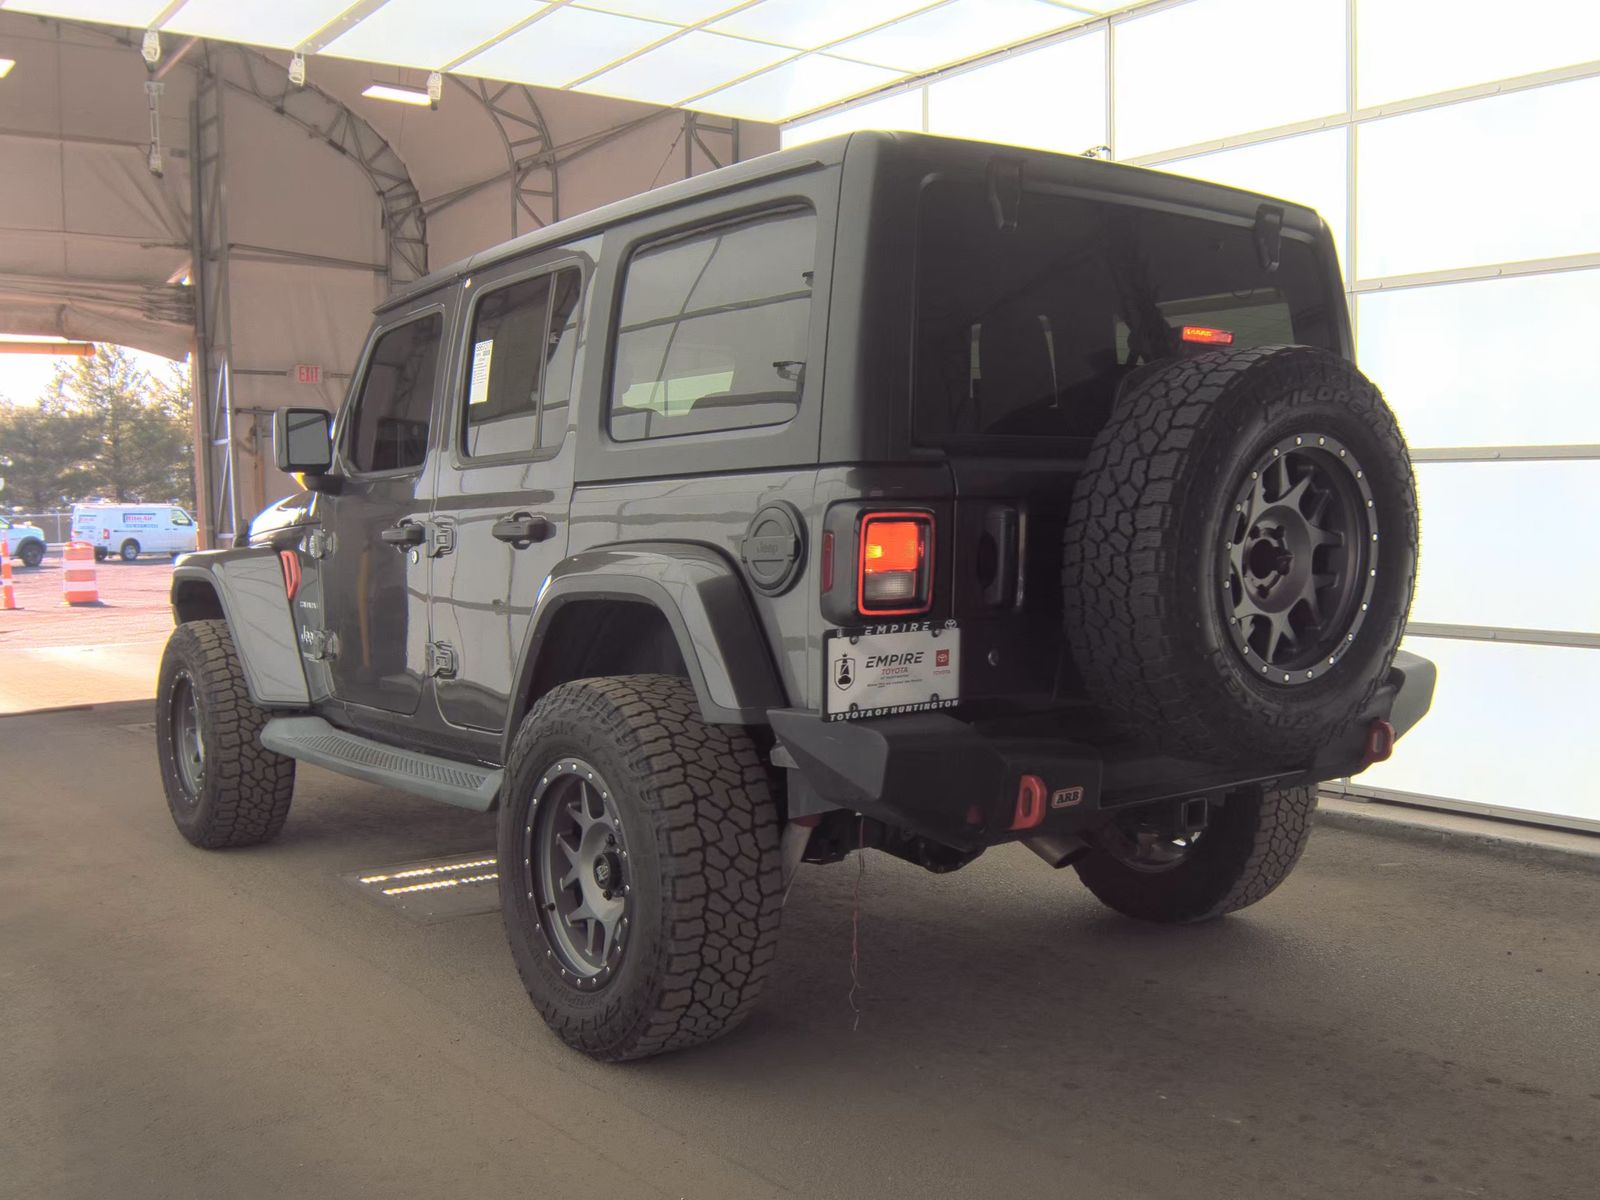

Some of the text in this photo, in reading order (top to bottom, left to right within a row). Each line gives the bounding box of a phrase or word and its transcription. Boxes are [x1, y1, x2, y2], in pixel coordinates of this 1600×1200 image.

[297, 365, 320, 384] EXIT
[865, 621, 930, 636] EMPIRE
[865, 652, 924, 668] EMPIRE
[881, 667, 908, 675] TOYOTA
[830, 700, 959, 722] TOYOTA OF HUNTINGTON
